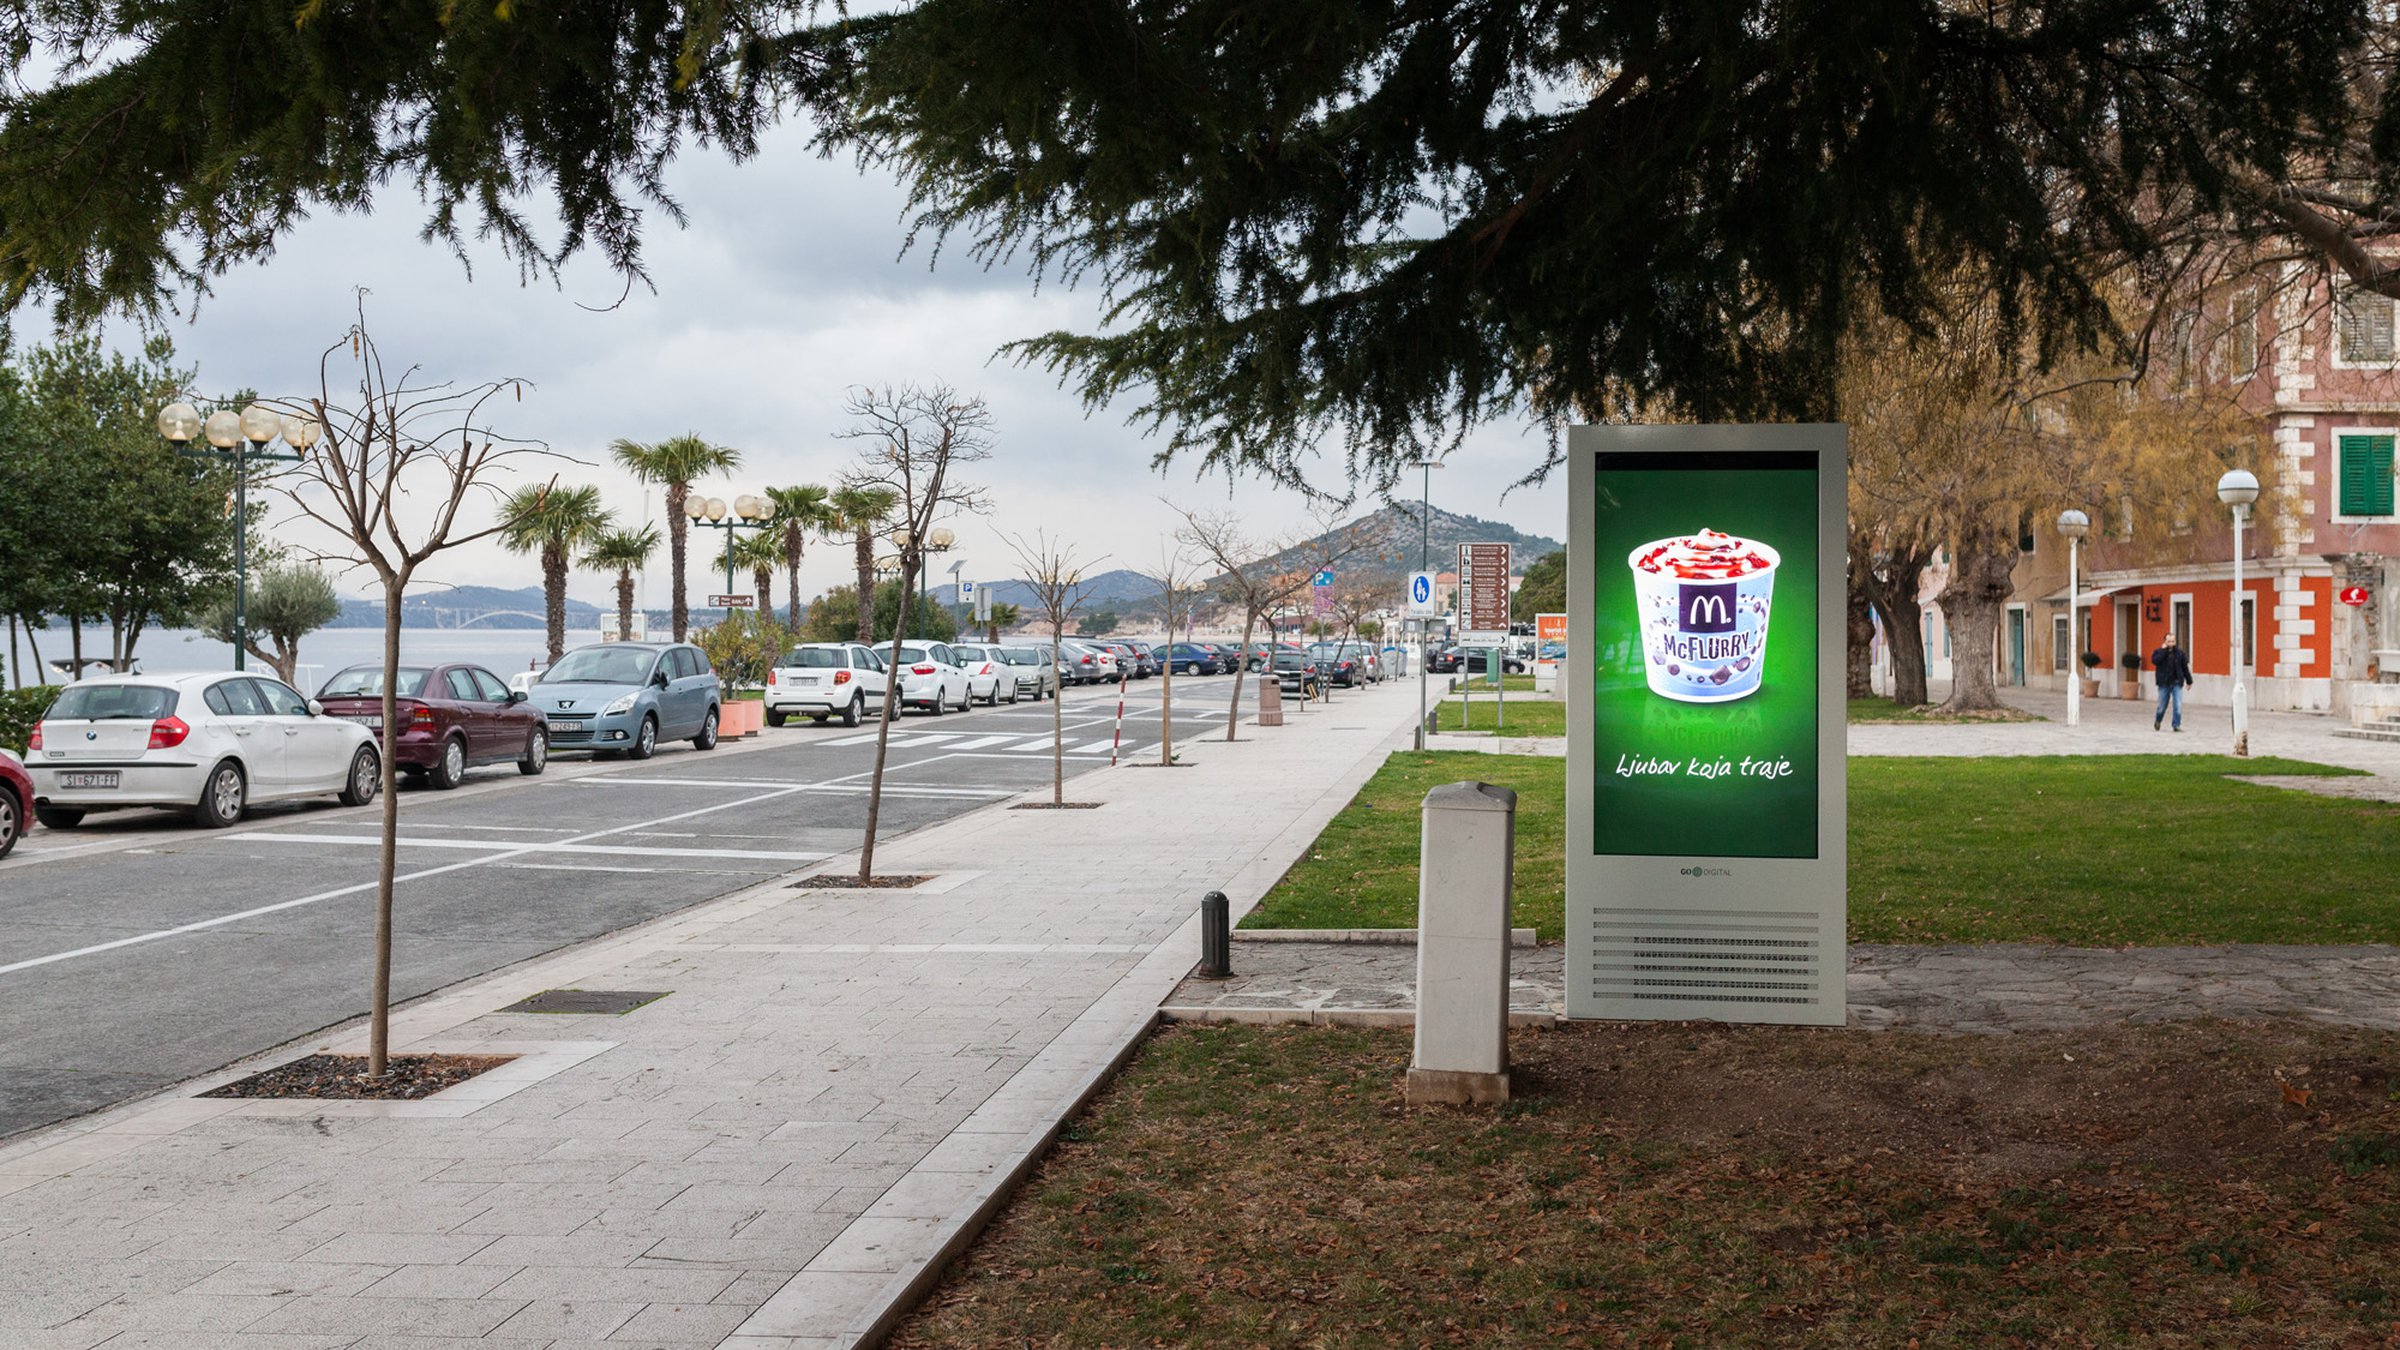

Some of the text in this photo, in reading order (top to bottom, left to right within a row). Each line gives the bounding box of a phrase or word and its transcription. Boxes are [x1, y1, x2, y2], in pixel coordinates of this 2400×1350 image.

[965, 583, 971, 591] P
[1615, 753, 1793, 780] Ljubav koja traje
